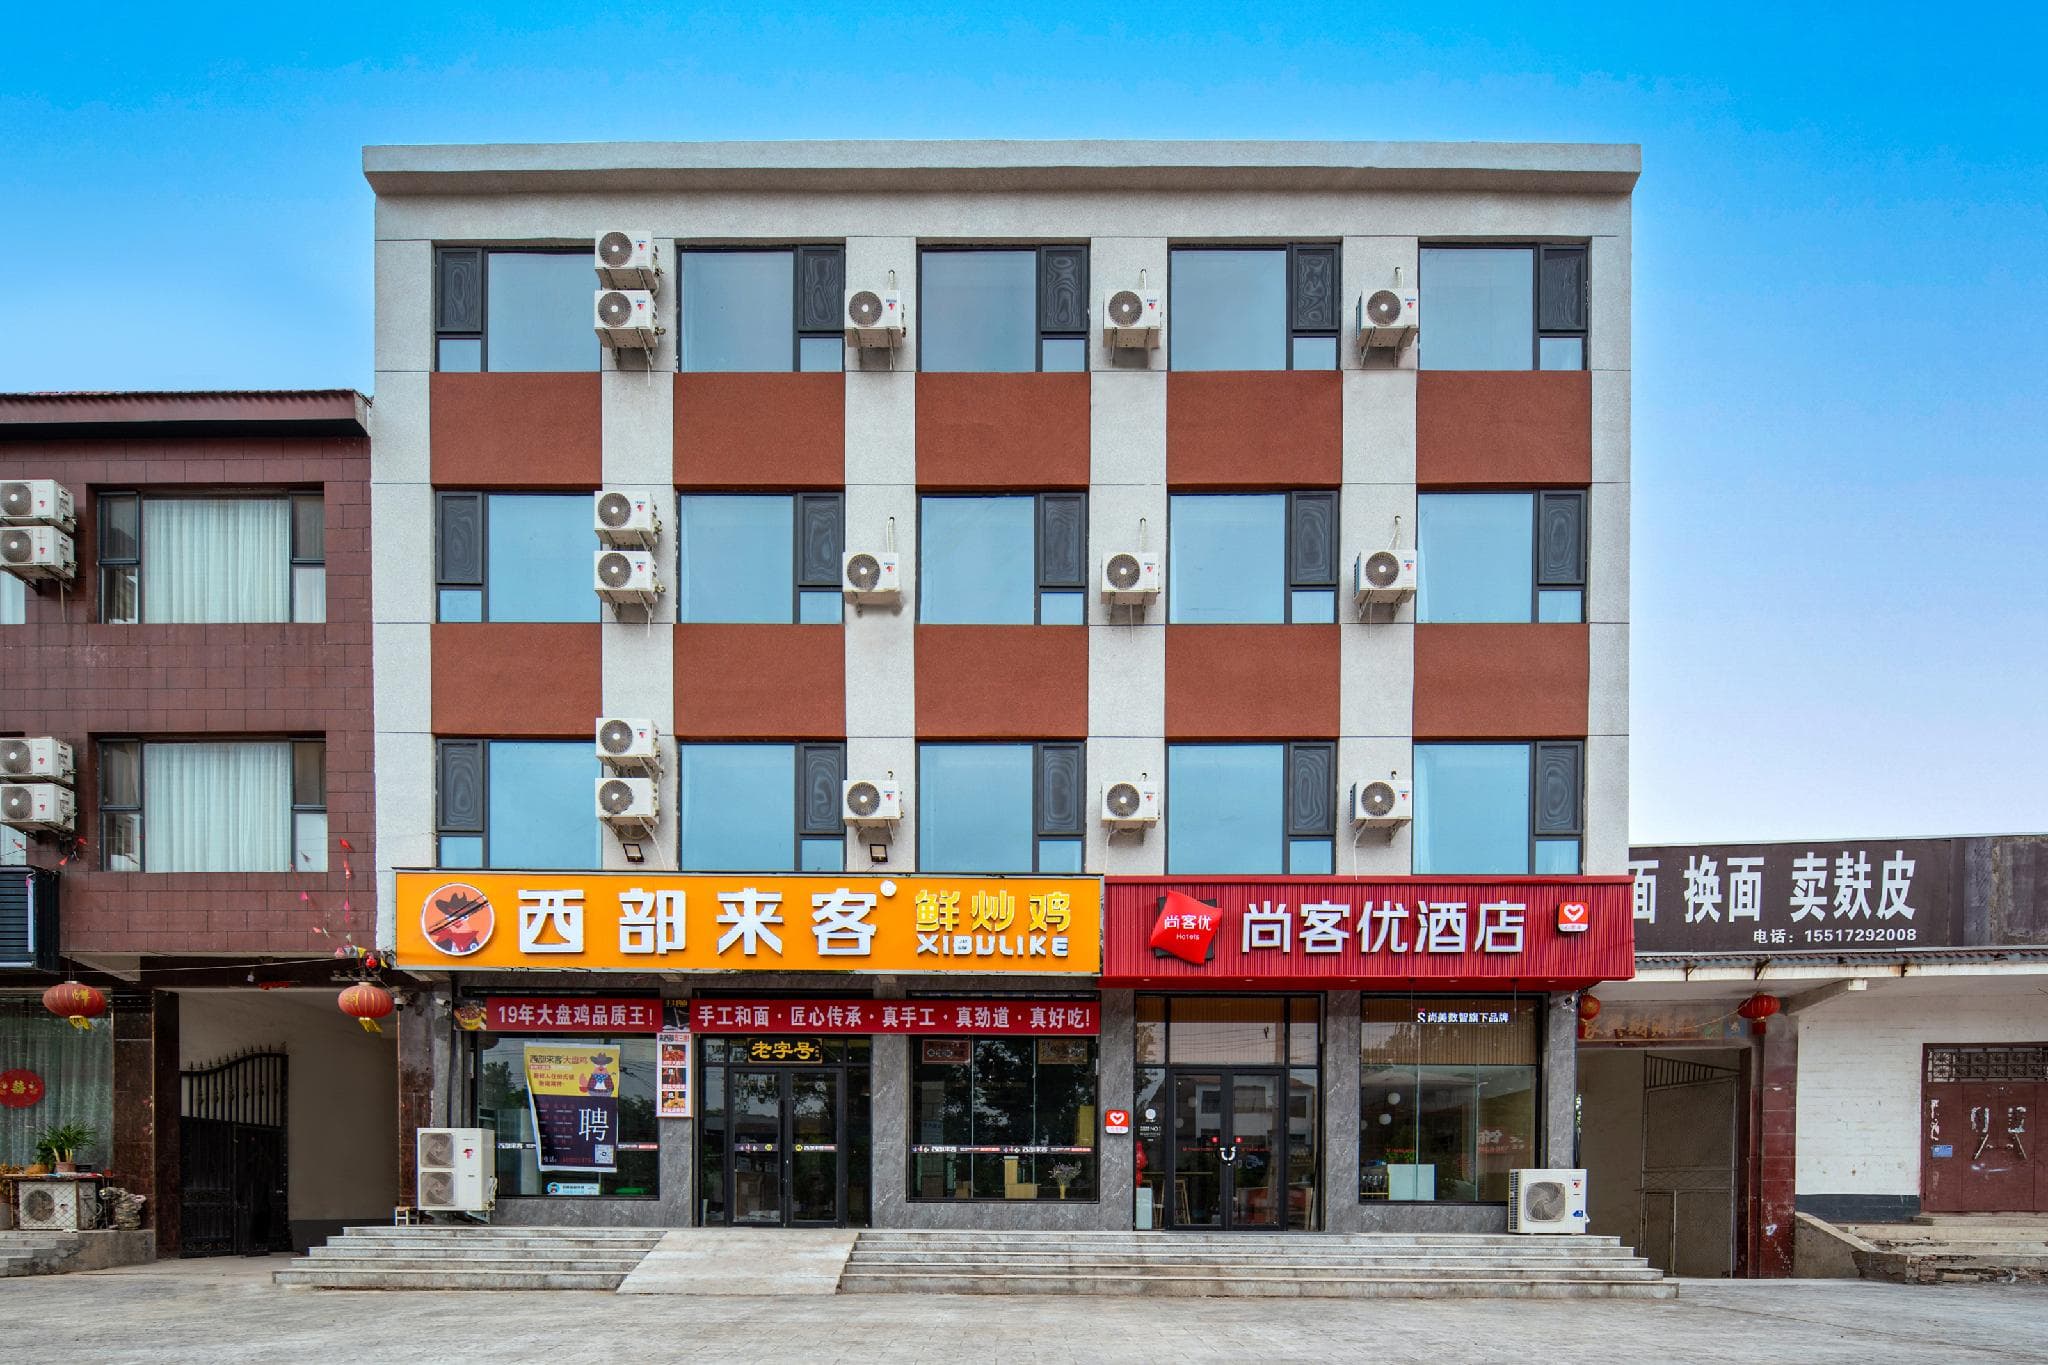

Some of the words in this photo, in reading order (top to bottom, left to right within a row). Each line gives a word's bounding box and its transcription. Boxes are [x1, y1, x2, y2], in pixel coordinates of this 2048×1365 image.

[1684, 854, 1765, 924] 换面
[1789, 849, 1917, 923] 卖麸皮
[517, 887, 877, 956] 西部来客
[916, 889, 1071, 932] 鲜炒鸡
[1164, 914, 1213, 932] 尚客优
[1241, 899, 1527, 954] 尚客优酒店
[916, 933, 1069, 957] XIBULIKE
[1176, 933, 1200, 941] Hotels
[751, 1040, 815, 1060] 老字号
[578, 1107, 609, 1142] 聘
